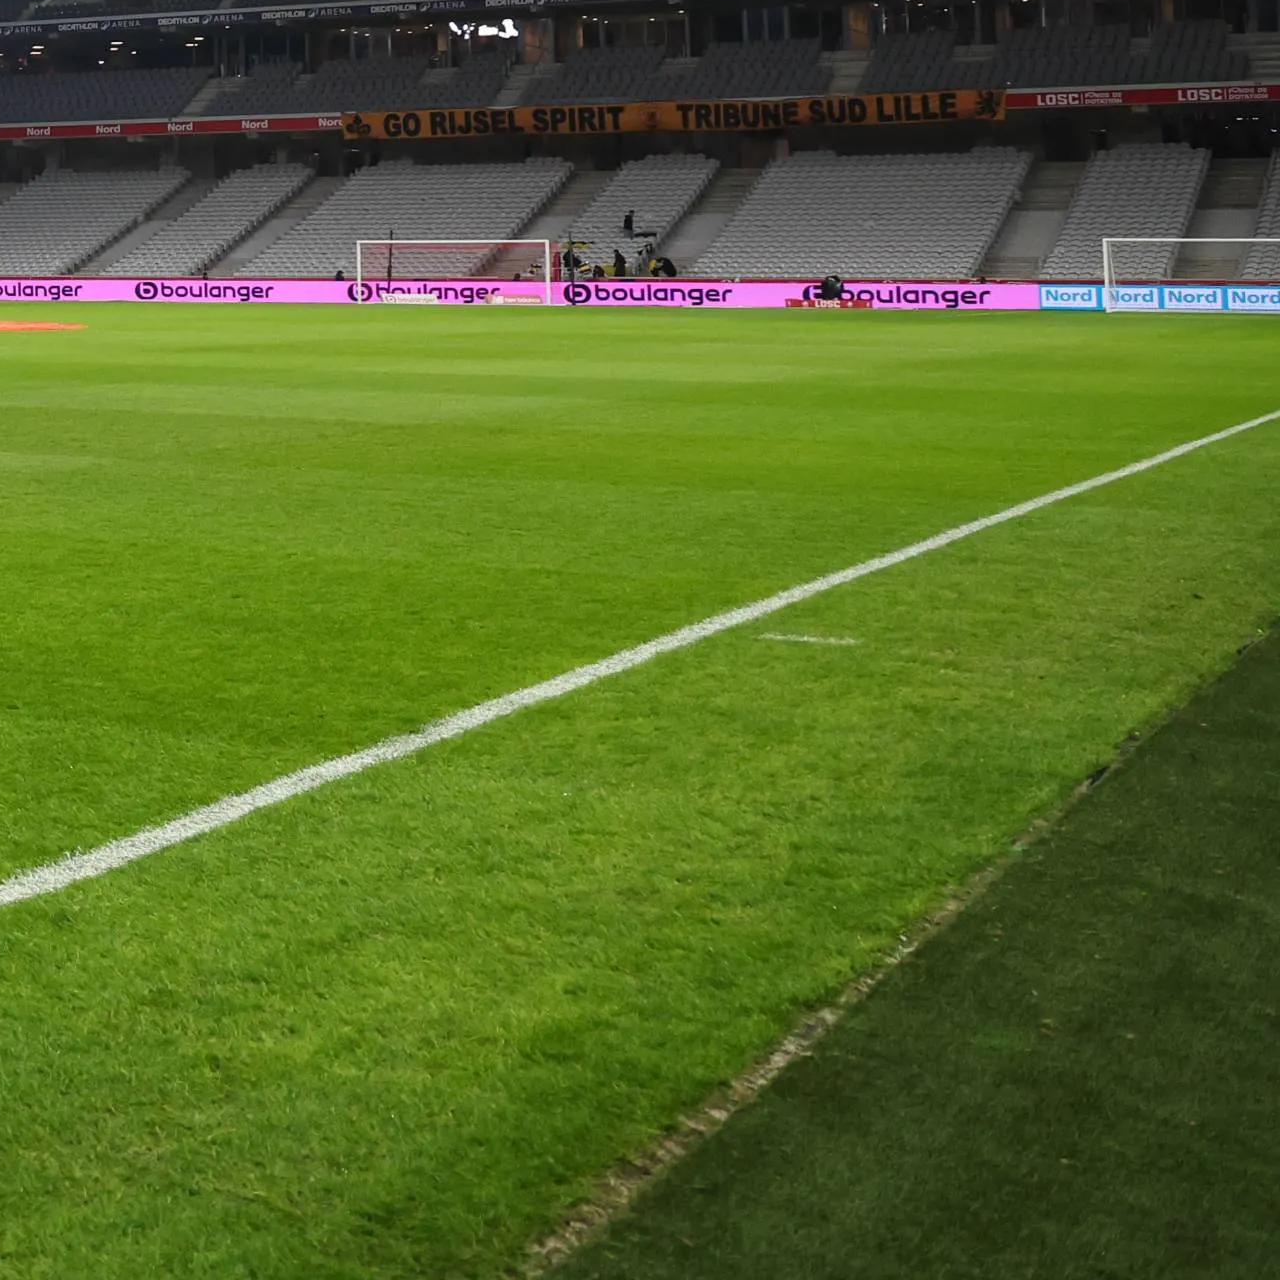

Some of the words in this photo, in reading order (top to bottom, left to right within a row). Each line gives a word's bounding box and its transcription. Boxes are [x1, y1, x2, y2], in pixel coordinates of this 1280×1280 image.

[370, 2, 417, 14] DECATHLON
[432, 0, 466, 11] ARENA
[157, 15, 200, 26] DECATHLON
[213, 13, 244, 23] ARENA
[260, 9, 306, 21] DECATHLON
[319, 7, 352, 17] ARENA
[14, 25, 43, 34] ARENA
[57, 21, 98, 32] DECATHLON
[111, 19, 141, 28] ARENA
[1036, 93, 1080, 106] LOSC
[1177, 88, 1223, 102] LOSC
[676, 101, 800, 130] TRIBUNE
[807, 97, 868, 124] SUD
[876, 92, 958, 122] LILLE
[167, 122, 193, 132] Nord
[241, 119, 269, 130] Nord
[382, 112, 421, 138] GO
[429, 109, 525, 136] RIJSEL
[532, 106, 625, 133] SPIRIT
[26, 126, 51, 137] Nord
[95, 124, 121, 134] Nord
[160, 281, 274, 302] boulanger
[595, 284, 733, 306] boulanger
[1045, 289, 1093, 303] Nord
[1167, 290, 1217, 304] Nord
[814, 299, 841, 308] LOSC
